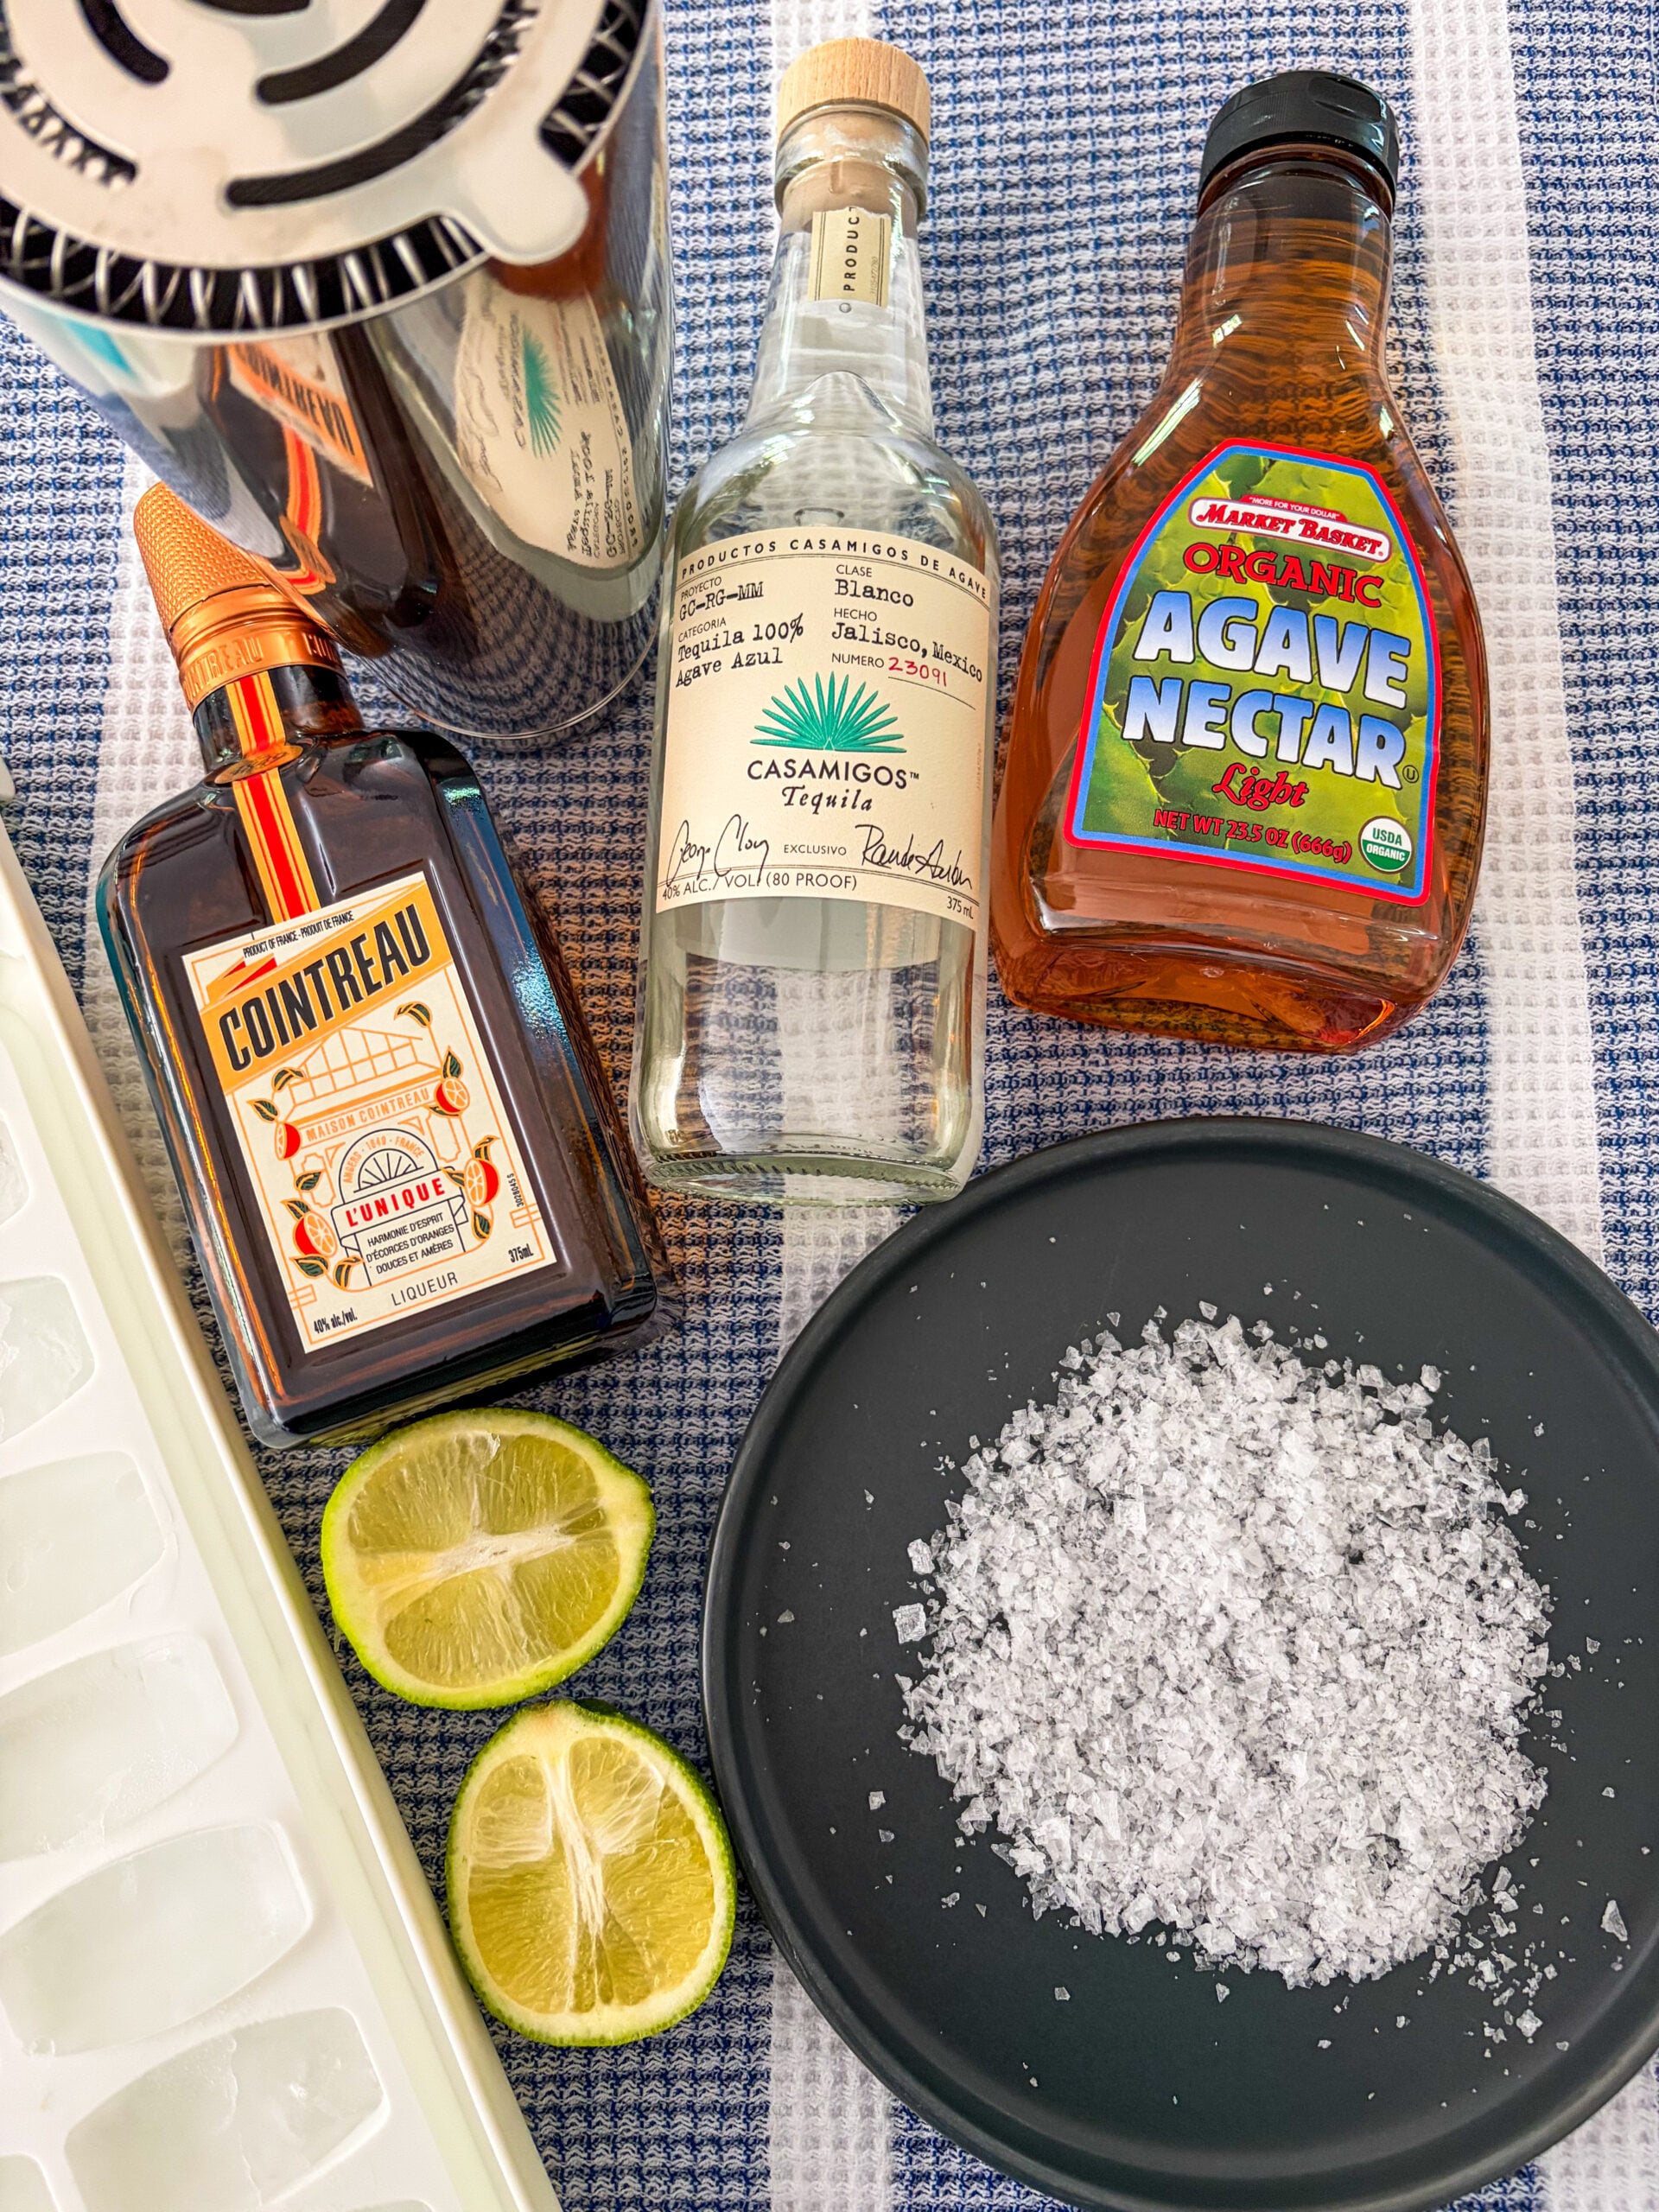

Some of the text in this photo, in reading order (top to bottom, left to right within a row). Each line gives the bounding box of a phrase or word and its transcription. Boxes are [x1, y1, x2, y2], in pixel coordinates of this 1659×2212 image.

[1197, 504, 1297, 535] MARKET
[1274, 499, 1288, 509] FOR
[1290, 502, 1309, 514] YOUR
[682, 539, 987, 599] PRODUCTOS CASAMIGOS DE AGAVE
[836, 564, 873, 578] CLASE
[1183, 542, 1384, 607] ORGANIC
[681, 576, 722, 601] PROYECTO
[835, 579, 914, 607] Blanco
[678, 617, 726, 643] CATEGORIA
[834, 607, 877, 622] HECHO
[677, 613, 804, 663] Tequila 100%
[831, 622, 983, 683] Jalisco, Mexico
[1133, 590, 1411, 709] AGAVE
[676, 647, 784, 688] Agave Azul
[831, 653, 948, 687] NUMERO 23091
[1121, 675, 1407, 791] NECTAR
[781, 785, 874, 816] Tequila
[1211, 762, 1310, 811] Light
[784, 844, 847, 856] EXCLUSIVO
[1154, 809, 1353, 865] NET WT 23.5 OZ (666g)
[1366, 843, 1406, 862] ORGANIC
[1372, 828, 1402, 847] USDA
[662, 883, 681, 901] 40%
[766, 873, 790, 888] (80
[796, 873, 858, 891] PROOF)
[242, 939, 268, 958] PRODUCT
[268, 938, 276, 950] OF
[276, 933, 298, 947] FRANCE
[301, 923, 322, 939] PRODUIT
[323, 918, 332, 931] DE
[332, 911, 354, 927] FRANCE
[219, 903, 431, 1071] COINTREAU
[306, 1087, 430, 1142] MAISON COINTREAU
[342, 1150, 363, 1184] ANGERS
[395, 1135, 425, 1158] FRANCE
[346, 1178, 446, 1227] L'UNIQUE
[365, 1224, 455, 1263] D'ÉCORCES D'ORANGES
[367, 1211, 444, 1248] HARMONIE D'ESPRIT
[376, 1239, 454, 1274] DOUCES ET AMÈRES
[391, 1272, 458, 1306] LIQUEUR
[314, 1308, 358, 1334] 40% alc./vol.
